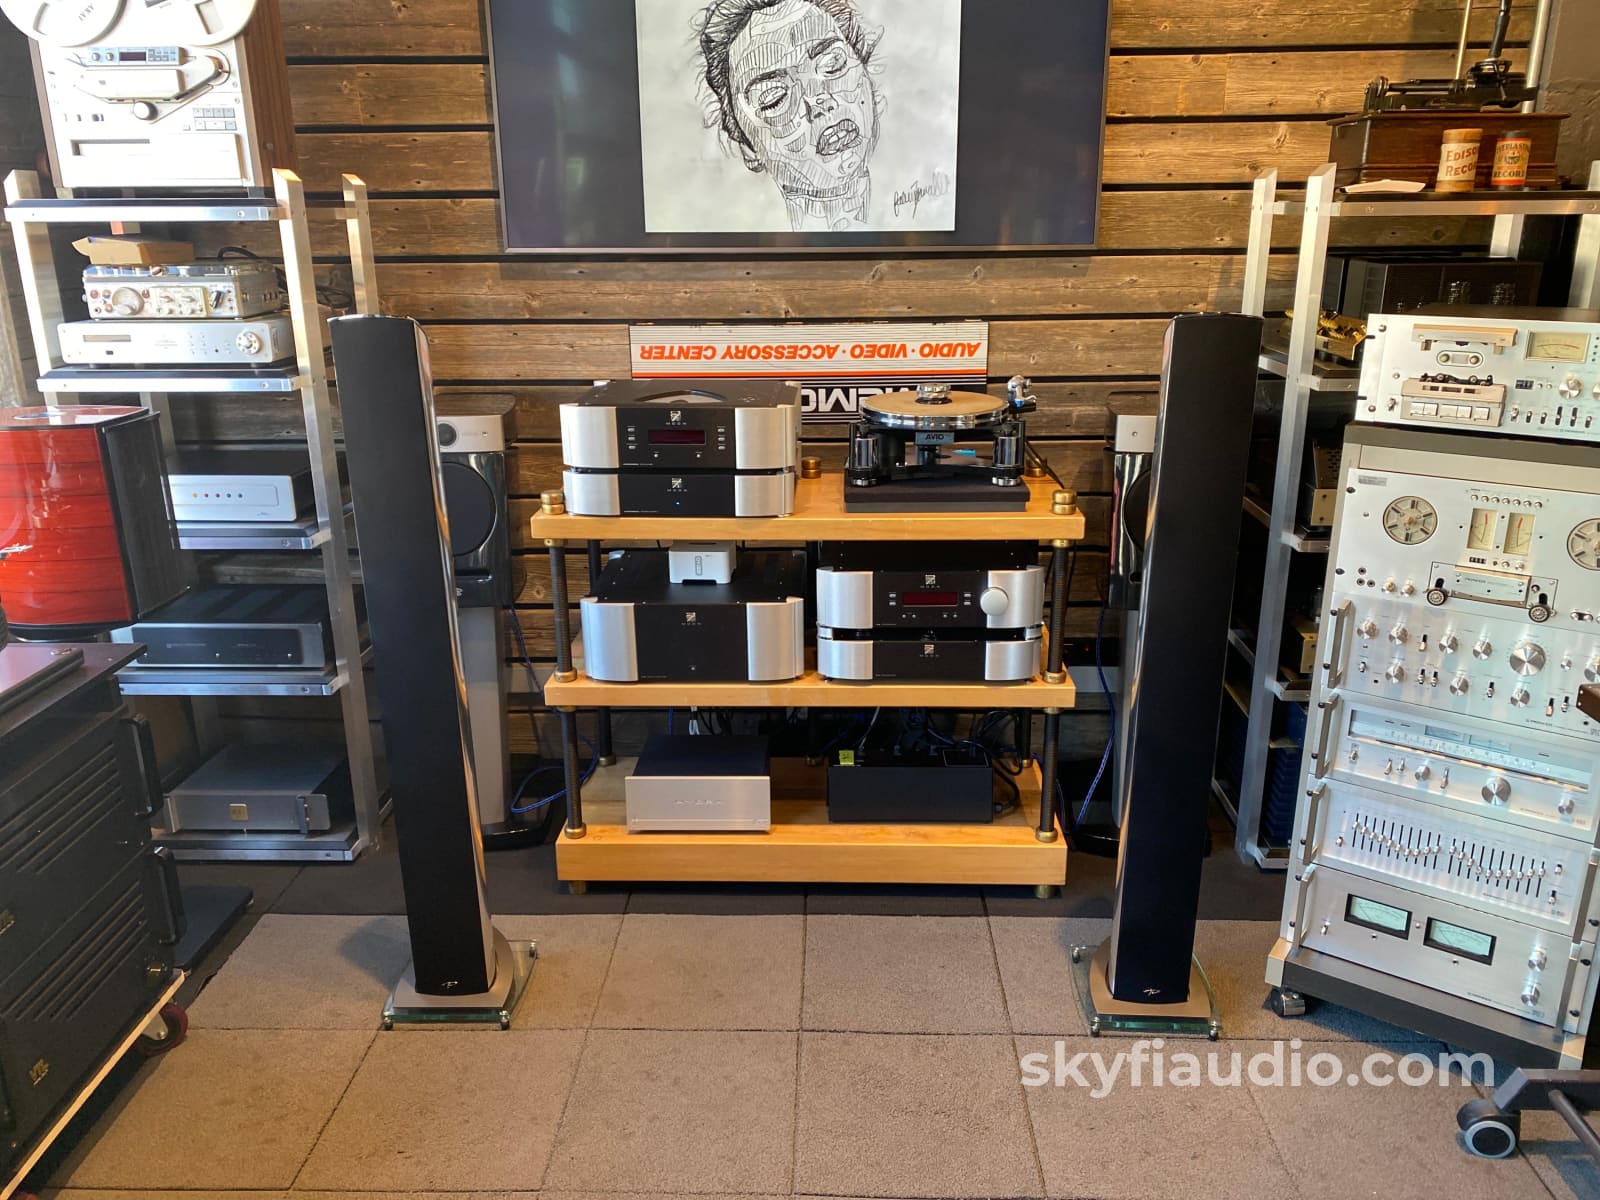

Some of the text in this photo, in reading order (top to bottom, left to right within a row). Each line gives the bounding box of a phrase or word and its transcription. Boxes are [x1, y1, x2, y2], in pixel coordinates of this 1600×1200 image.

[1445, 162, 1475, 177] RECO
[640, 342, 982, 360] AUDIO VIDEO ACCESSORY CENTER
[925, 433, 945, 441] AVID
